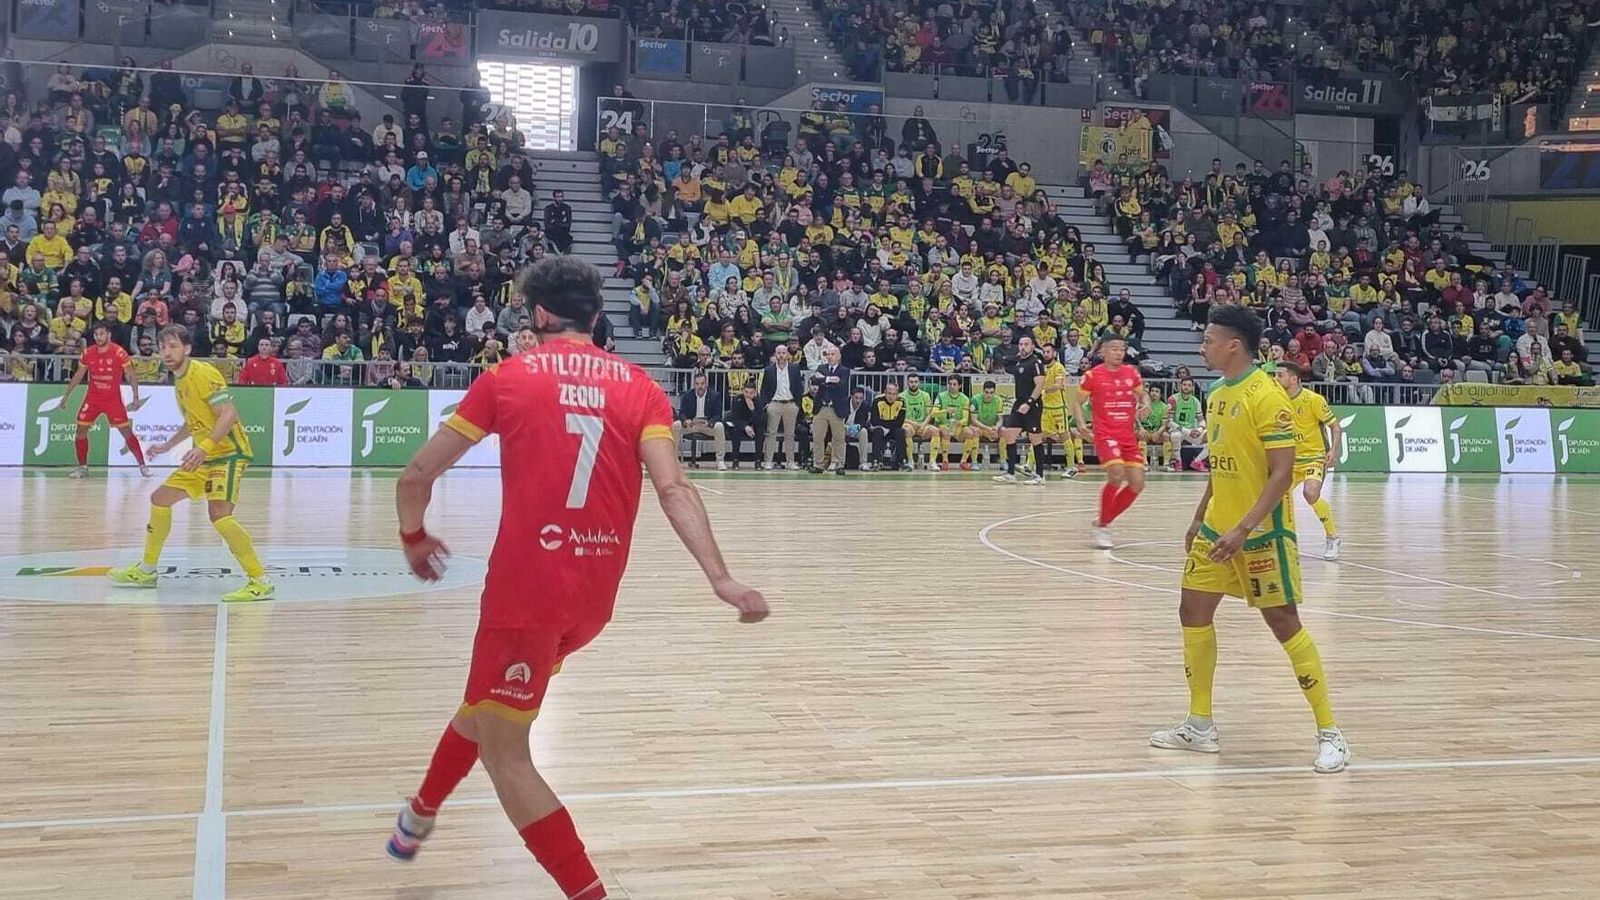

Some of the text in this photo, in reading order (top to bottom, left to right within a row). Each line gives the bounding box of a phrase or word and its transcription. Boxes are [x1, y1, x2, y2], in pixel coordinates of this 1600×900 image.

[498, 22, 599, 52] Salida 10
[639, 39, 668, 50] Sector
[1304, 79, 1383, 105] Salida 11
[599, 110, 633, 135] 24
[1369, 155, 1394, 177] 26
[1464, 160, 1491, 181] 26
[558, 382, 605, 409] ZEQUI
[297, 424, 343, 434] DIPUTACIÓN
[375, 425, 421, 434] DIPUTACIÓN
[1404, 437, 1438, 445] DIPUTACIÓN
[1514, 438, 1547, 446] DIPUTACIÓN
[1568, 439, 1599, 447] DIPUTACIÓN
[565, 413, 605, 509] 7
